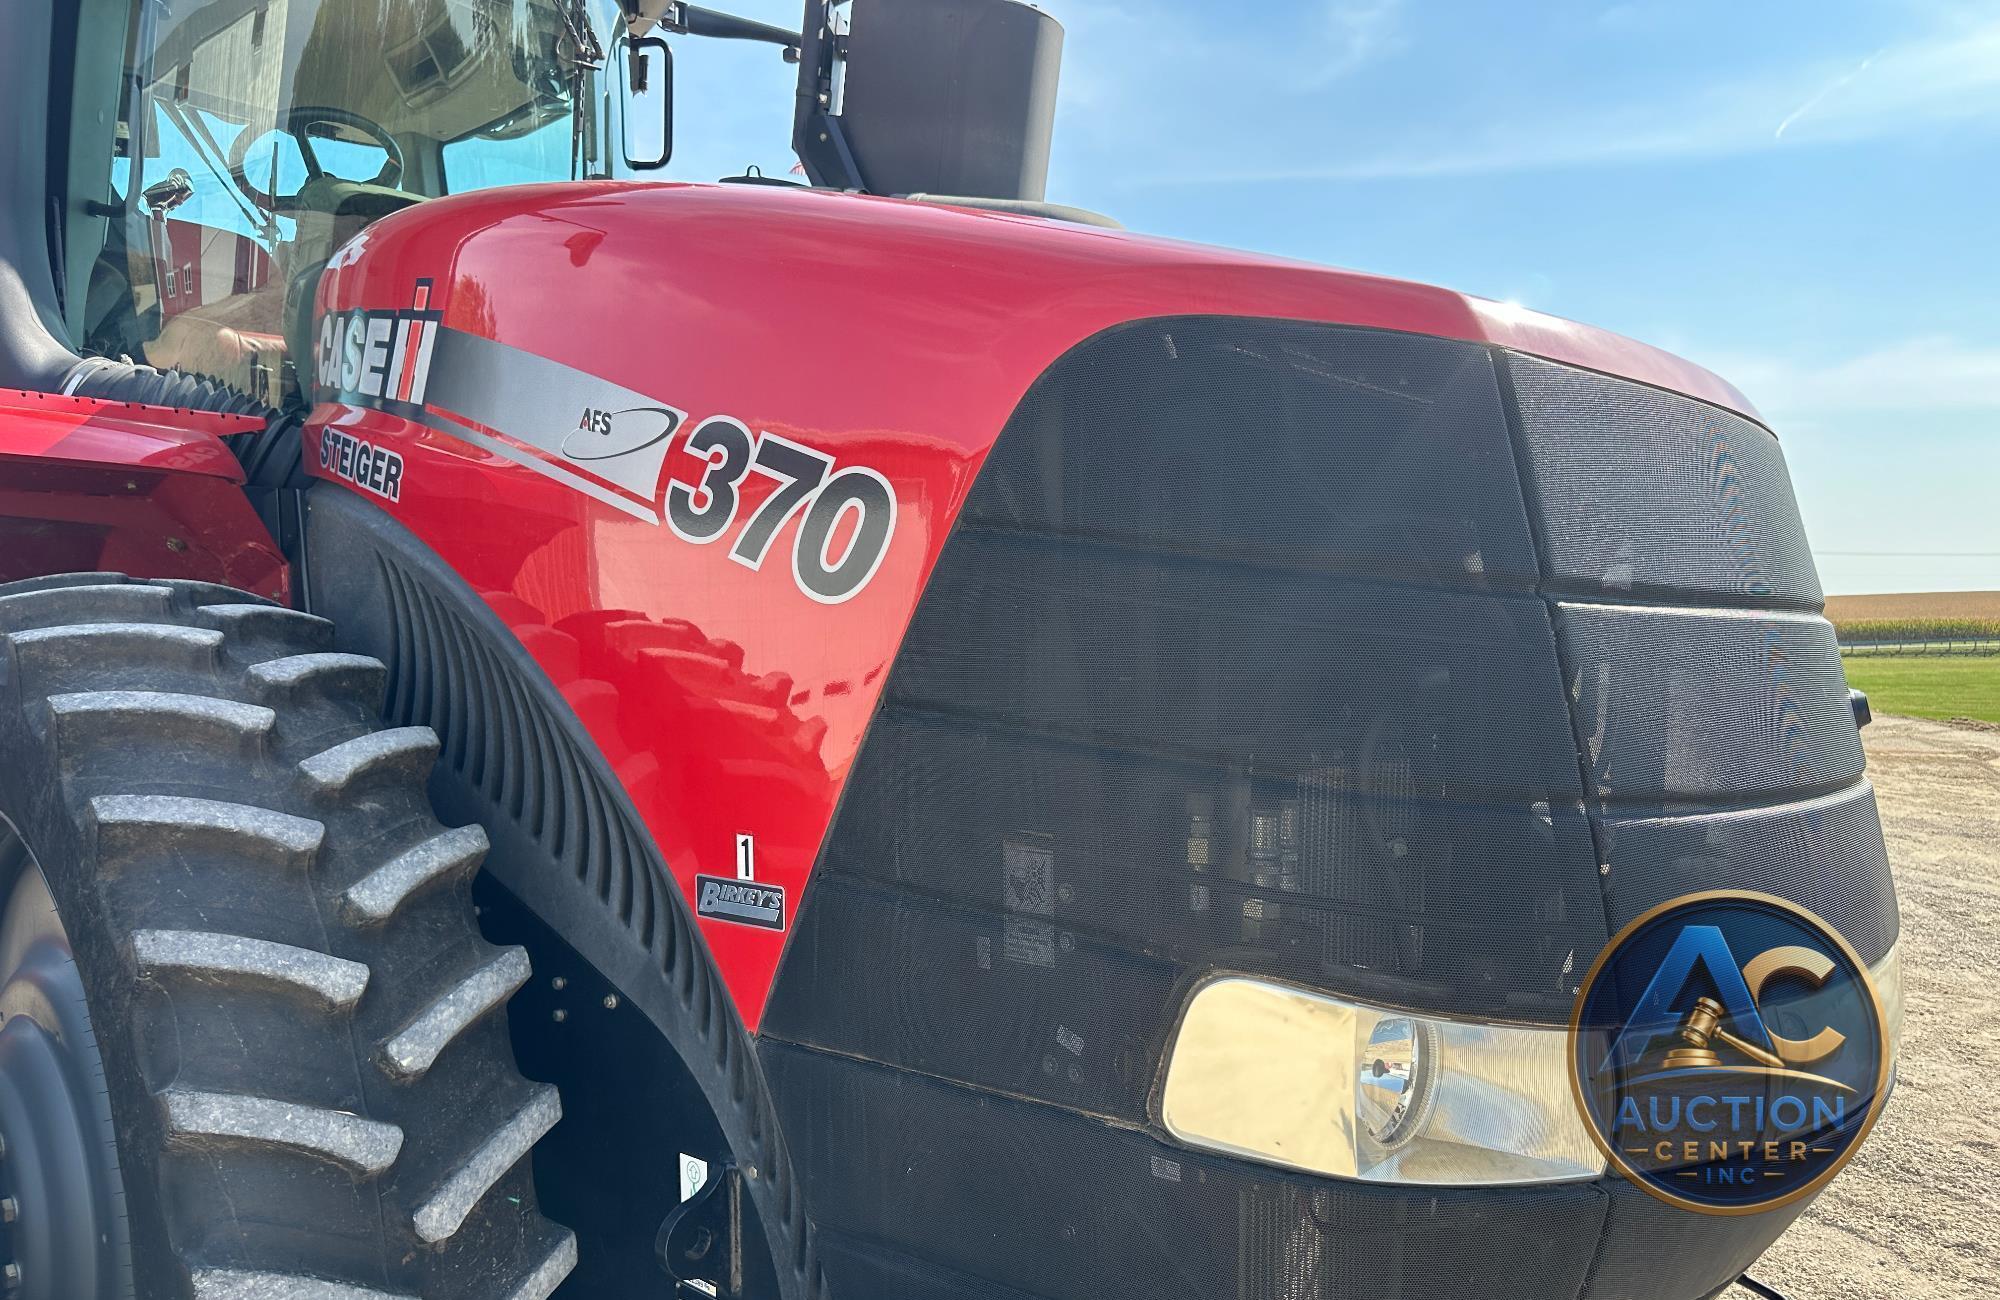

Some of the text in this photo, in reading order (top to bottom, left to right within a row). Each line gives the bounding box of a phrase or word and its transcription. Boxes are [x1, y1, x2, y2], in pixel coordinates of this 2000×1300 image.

[318, 313, 393, 396] CASE
[579, 407, 612, 436] AFS
[319, 424, 404, 504] STEIGER
[666, 416, 897, 604] 370
[741, 838, 750, 877] 1
